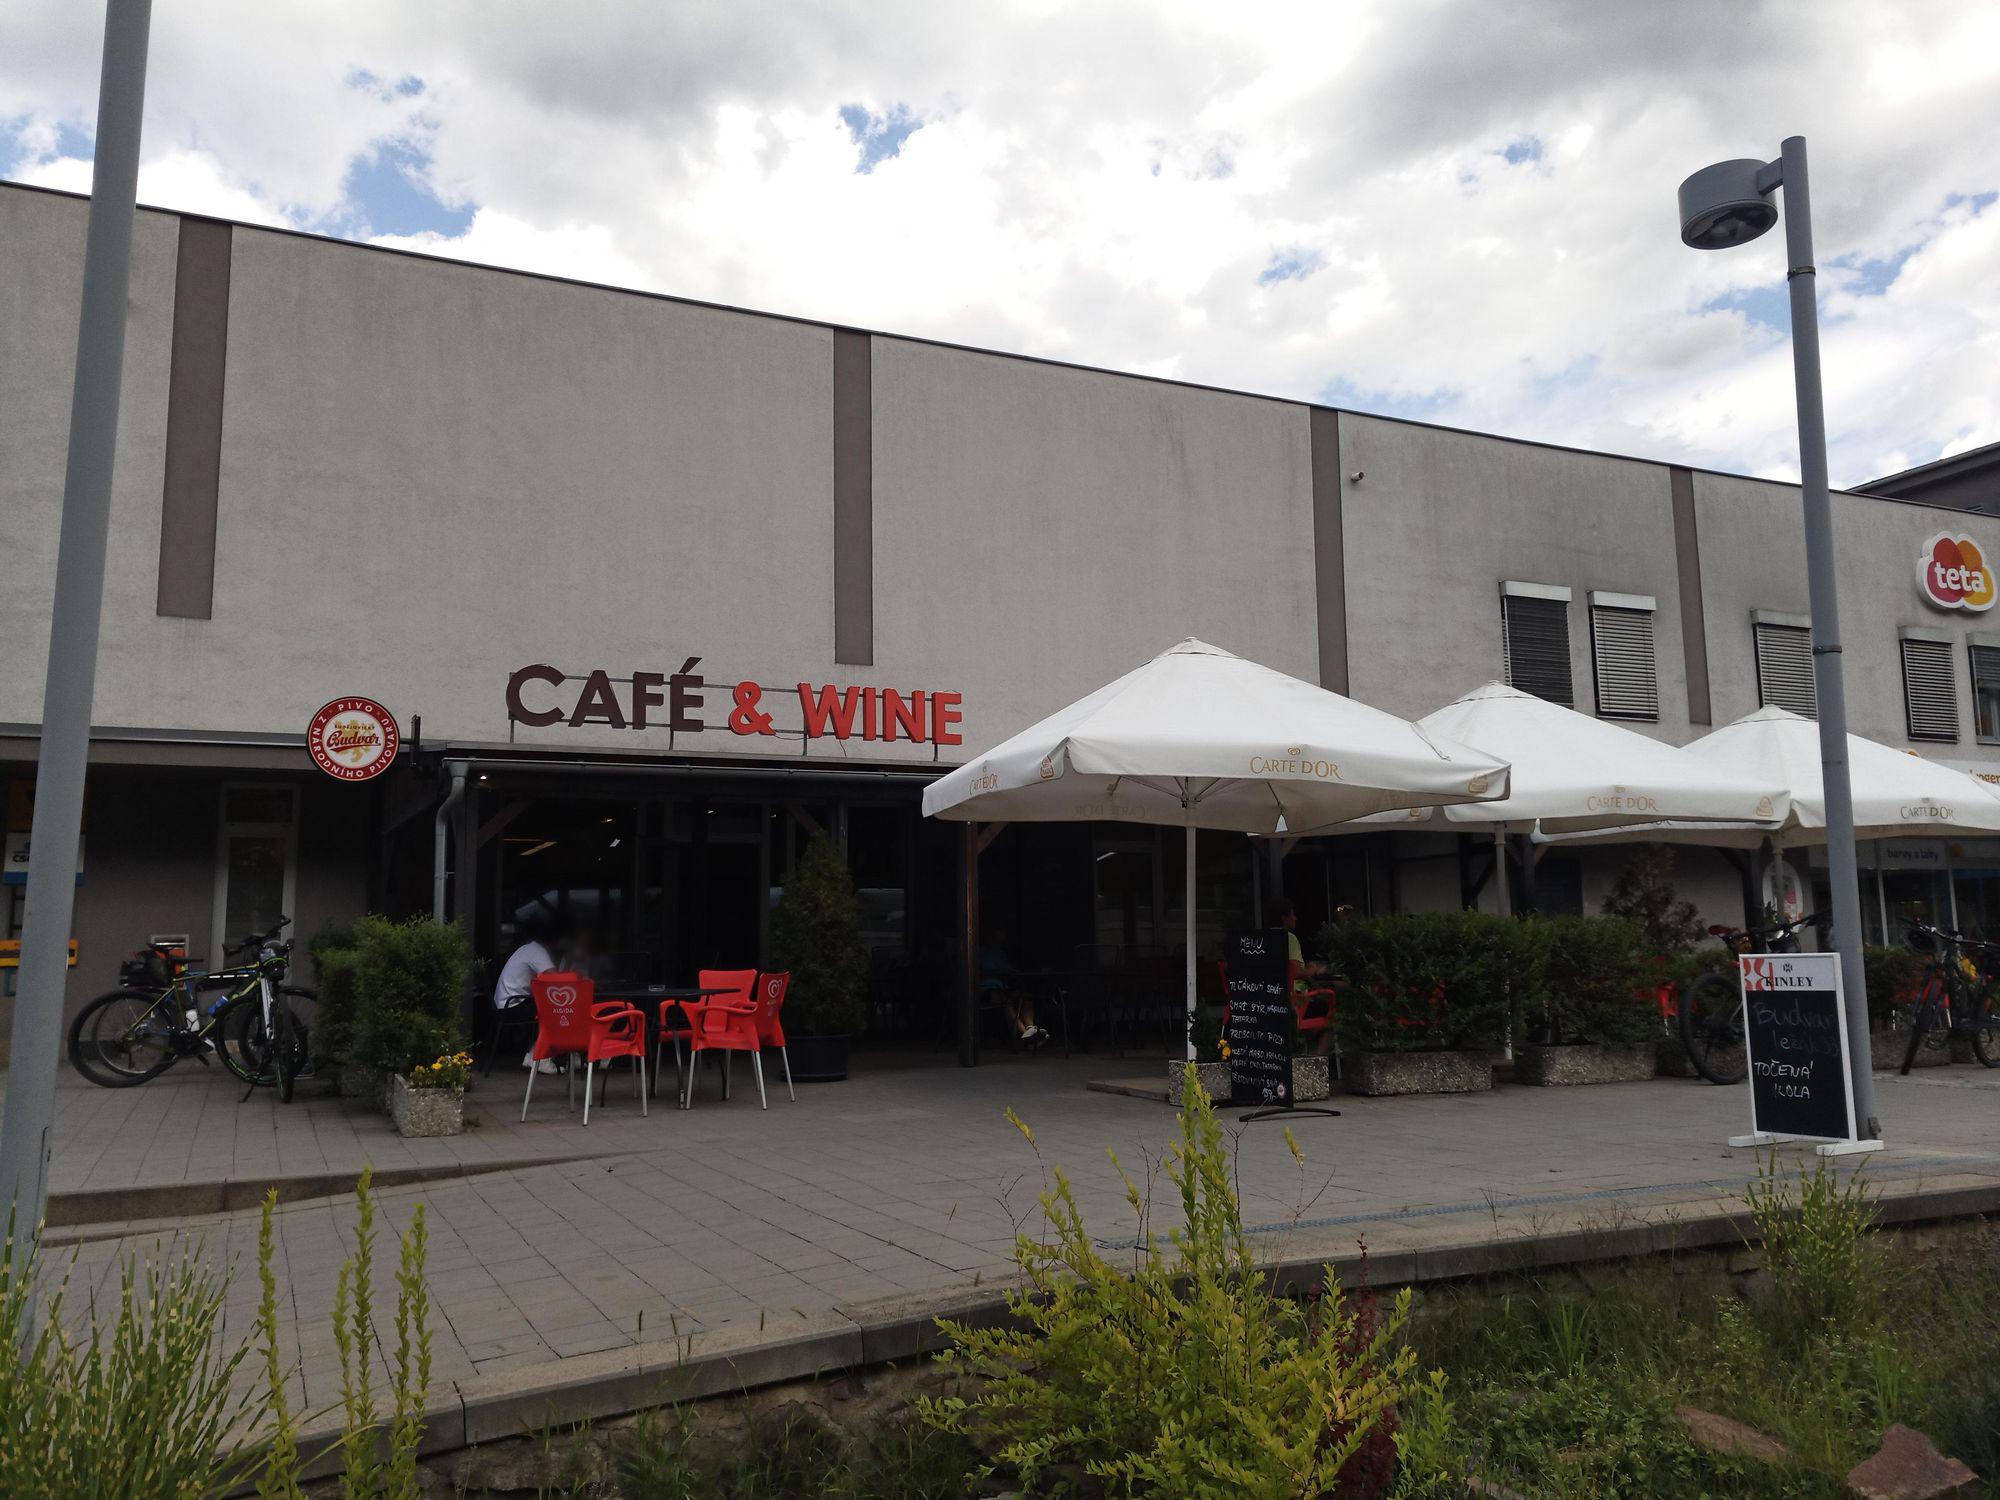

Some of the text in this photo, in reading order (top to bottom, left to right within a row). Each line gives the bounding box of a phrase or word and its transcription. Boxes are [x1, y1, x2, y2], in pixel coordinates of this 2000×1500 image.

[1934, 562, 1987, 593] teta
[338, 702, 373, 713] PIVO
[506, 657, 963, 745] CAFÉ & WINE
[312, 715, 395, 778] Z NÁRODNÍHO PIVOVARU
[326, 730, 381, 748] Budvar
[1250, 756, 1344, 781] CARTE D'OR
[1765, 976, 1814, 987] KINLEY
